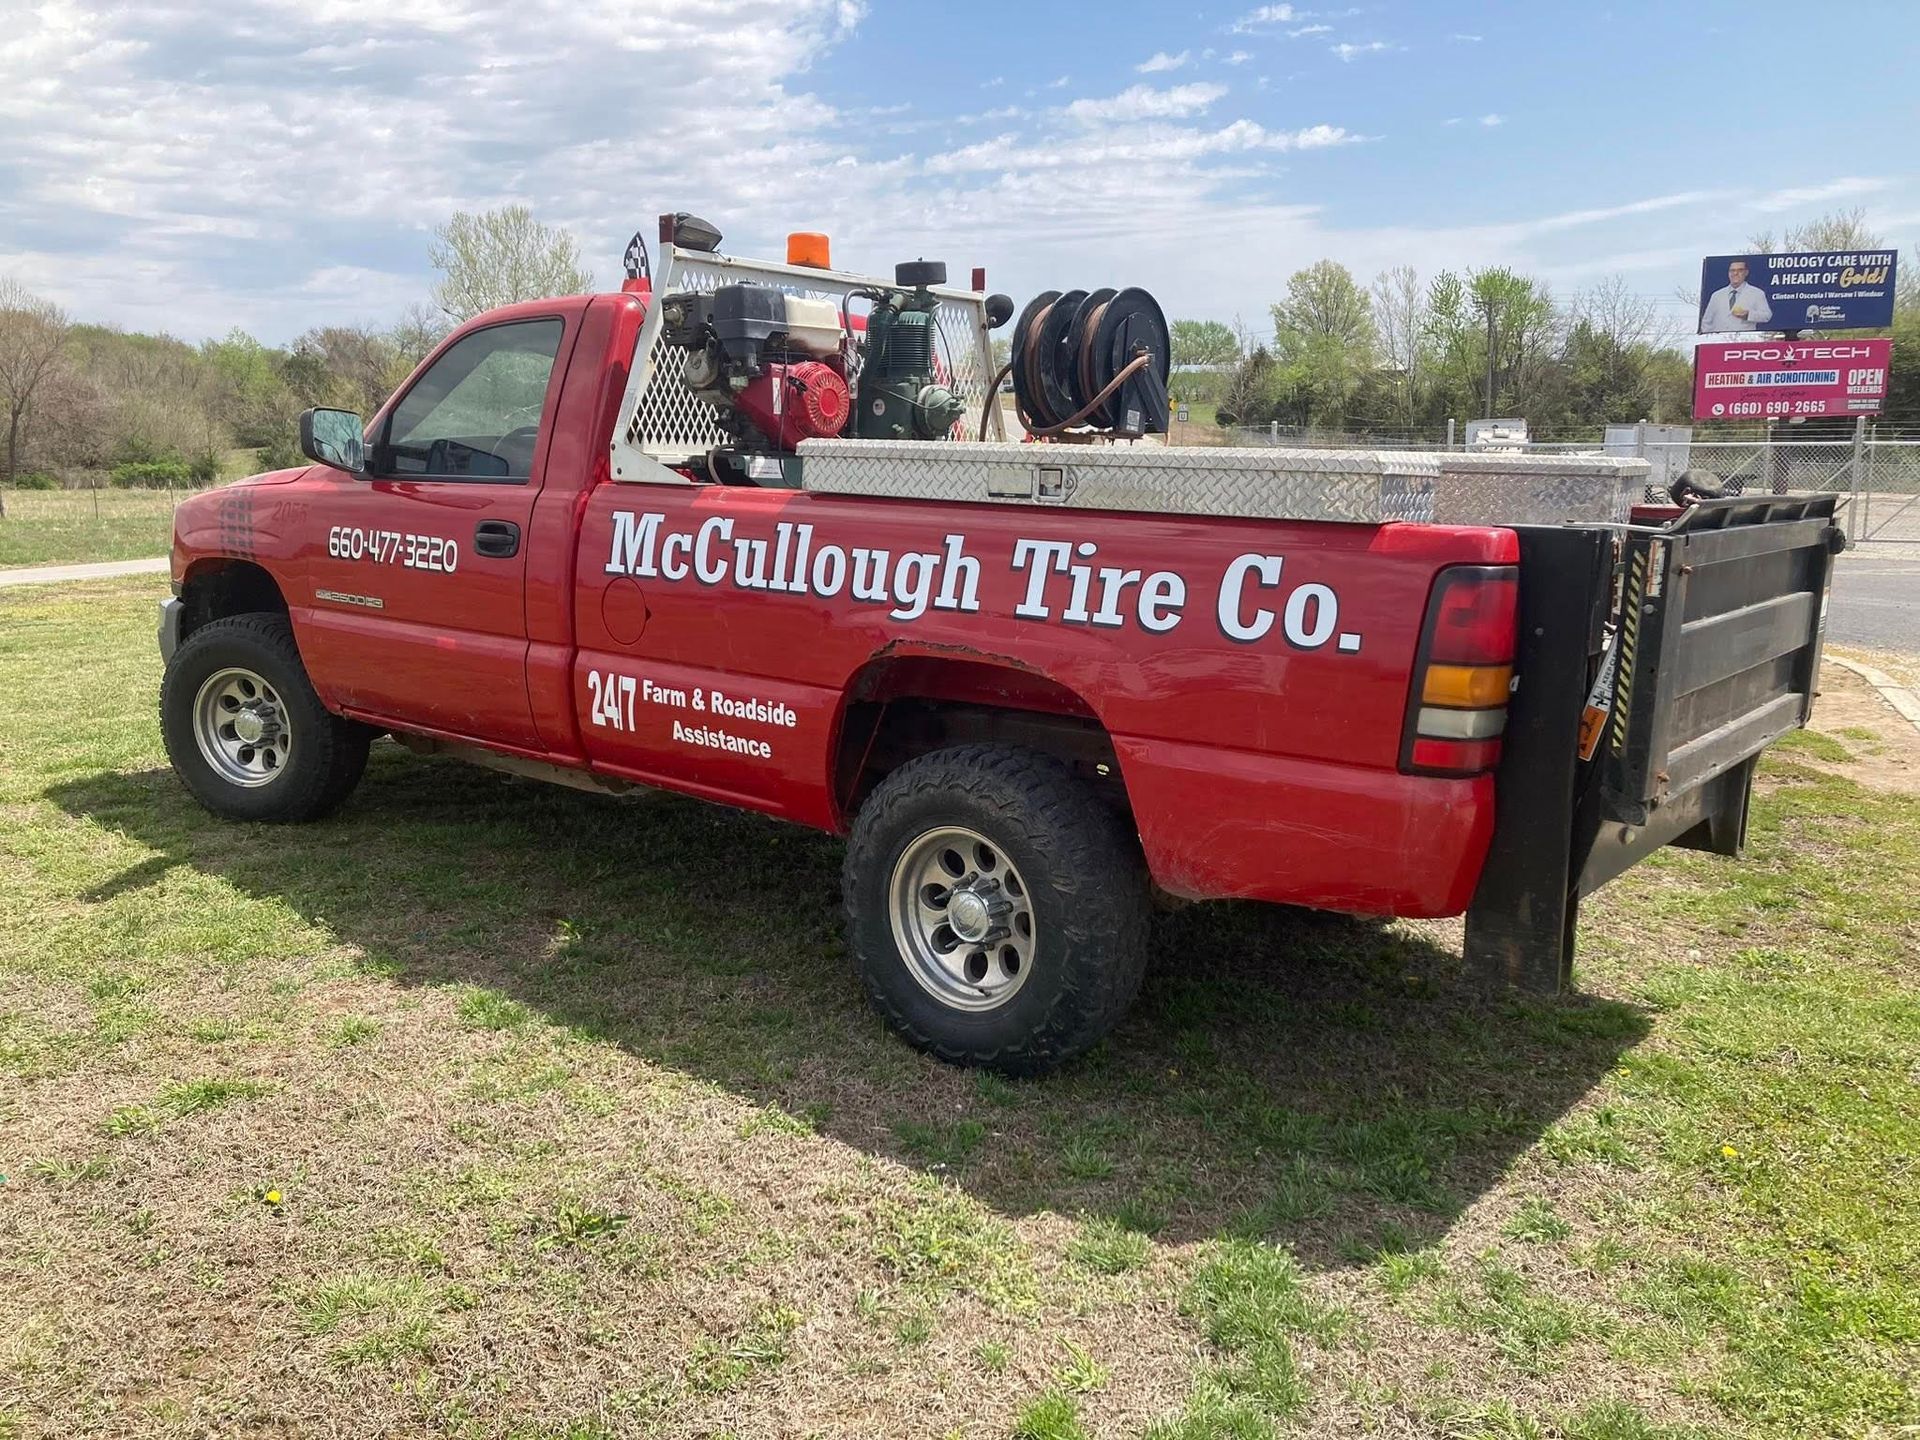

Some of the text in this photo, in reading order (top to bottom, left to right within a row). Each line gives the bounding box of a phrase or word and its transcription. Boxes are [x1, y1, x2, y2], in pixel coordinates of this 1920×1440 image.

[1768, 254, 1892, 269] UROLOGY CARE WITH
[1770, 266, 1889, 288] A HEART OF Gold!
[1723, 347, 1870, 362] PRO TECH
[1708, 371, 1836, 385] HEATING & AIR CONDITIONING
[1847, 368, 1884, 386] OPEN
[1729, 400, 1826, 415] (660) 690-2665
[328, 526, 458, 573] 660-477-3220
[605, 510, 1361, 650] McCullough Tire Co.
[588, 670, 797, 732] 24/7 Farm & Roadside
[673, 720, 772, 759] Assistance
